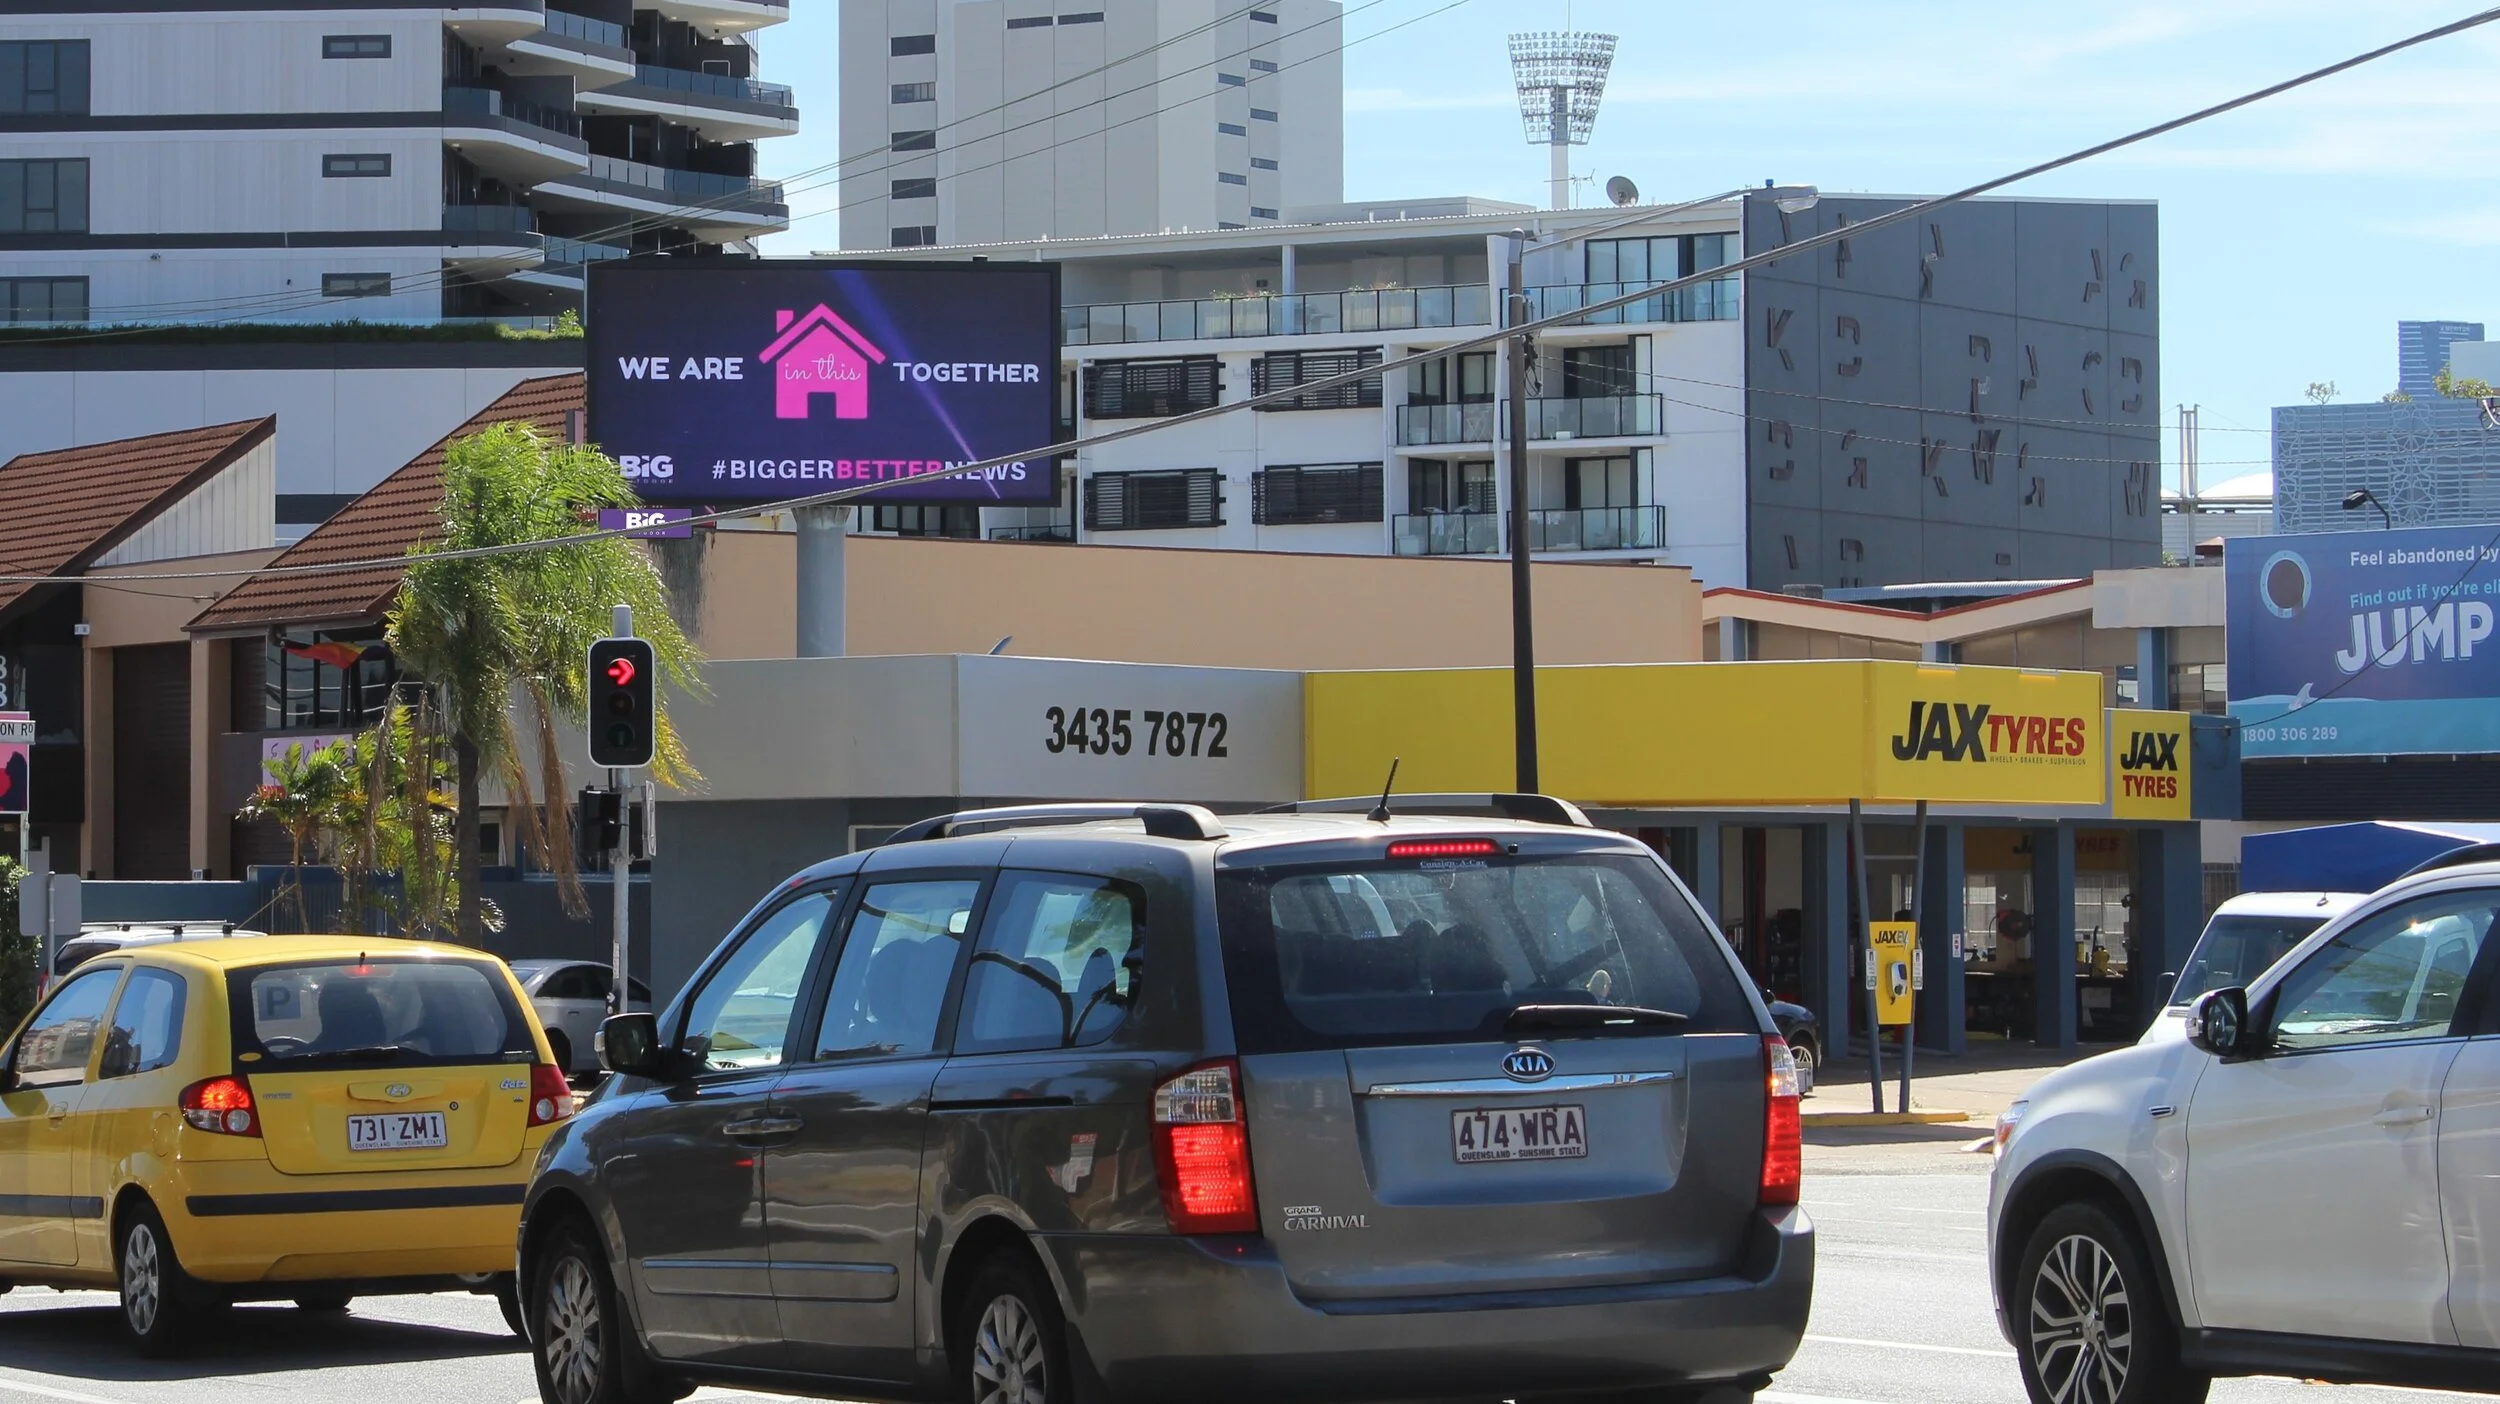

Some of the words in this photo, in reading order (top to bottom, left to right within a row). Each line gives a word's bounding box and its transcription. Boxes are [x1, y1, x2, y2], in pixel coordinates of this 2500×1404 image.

[618, 356, 670, 380] WE
[679, 356, 744, 380] ARE
[784, 362, 813, 381] in
[811, 353, 862, 381] this
[893, 362, 1040, 383] TOGETHER
[2350, 550, 2383, 567] Feel
[2388, 546, 2475, 565] abandoned
[2481, 545, 2500, 563] by
[2350, 589, 2383, 609] Find
[2387, 586, 2412, 602] out
[2417, 583, 2428, 599] if
[2432, 581, 2479, 600] you're
[2335, 601, 2494, 675] JUMP
[1045, 706, 1133, 756] 3435
[1144, 710, 1228, 758] 7872
[1987, 714, 2086, 757] TYRES
[2242, 728, 2276, 742] 1800
[2281, 727, 2307, 741] 306
[2312, 726, 2338, 740] 289
[2120, 732, 2180, 771] JAX
[2122, 774, 2178, 799] TYRES
[267, 986, 291, 1017] P
[1510, 1055, 1548, 1072] KIA
[1462, 1150, 1511, 1160] QUEENSLAND
[1518, 1148, 1555, 1157] SUNSHINE
[1559, 1146, 1581, 1155] STATE
[1284, 1214, 1371, 1231] CARNIVAL
[1285, 1206, 1321, 1215] GRAND
